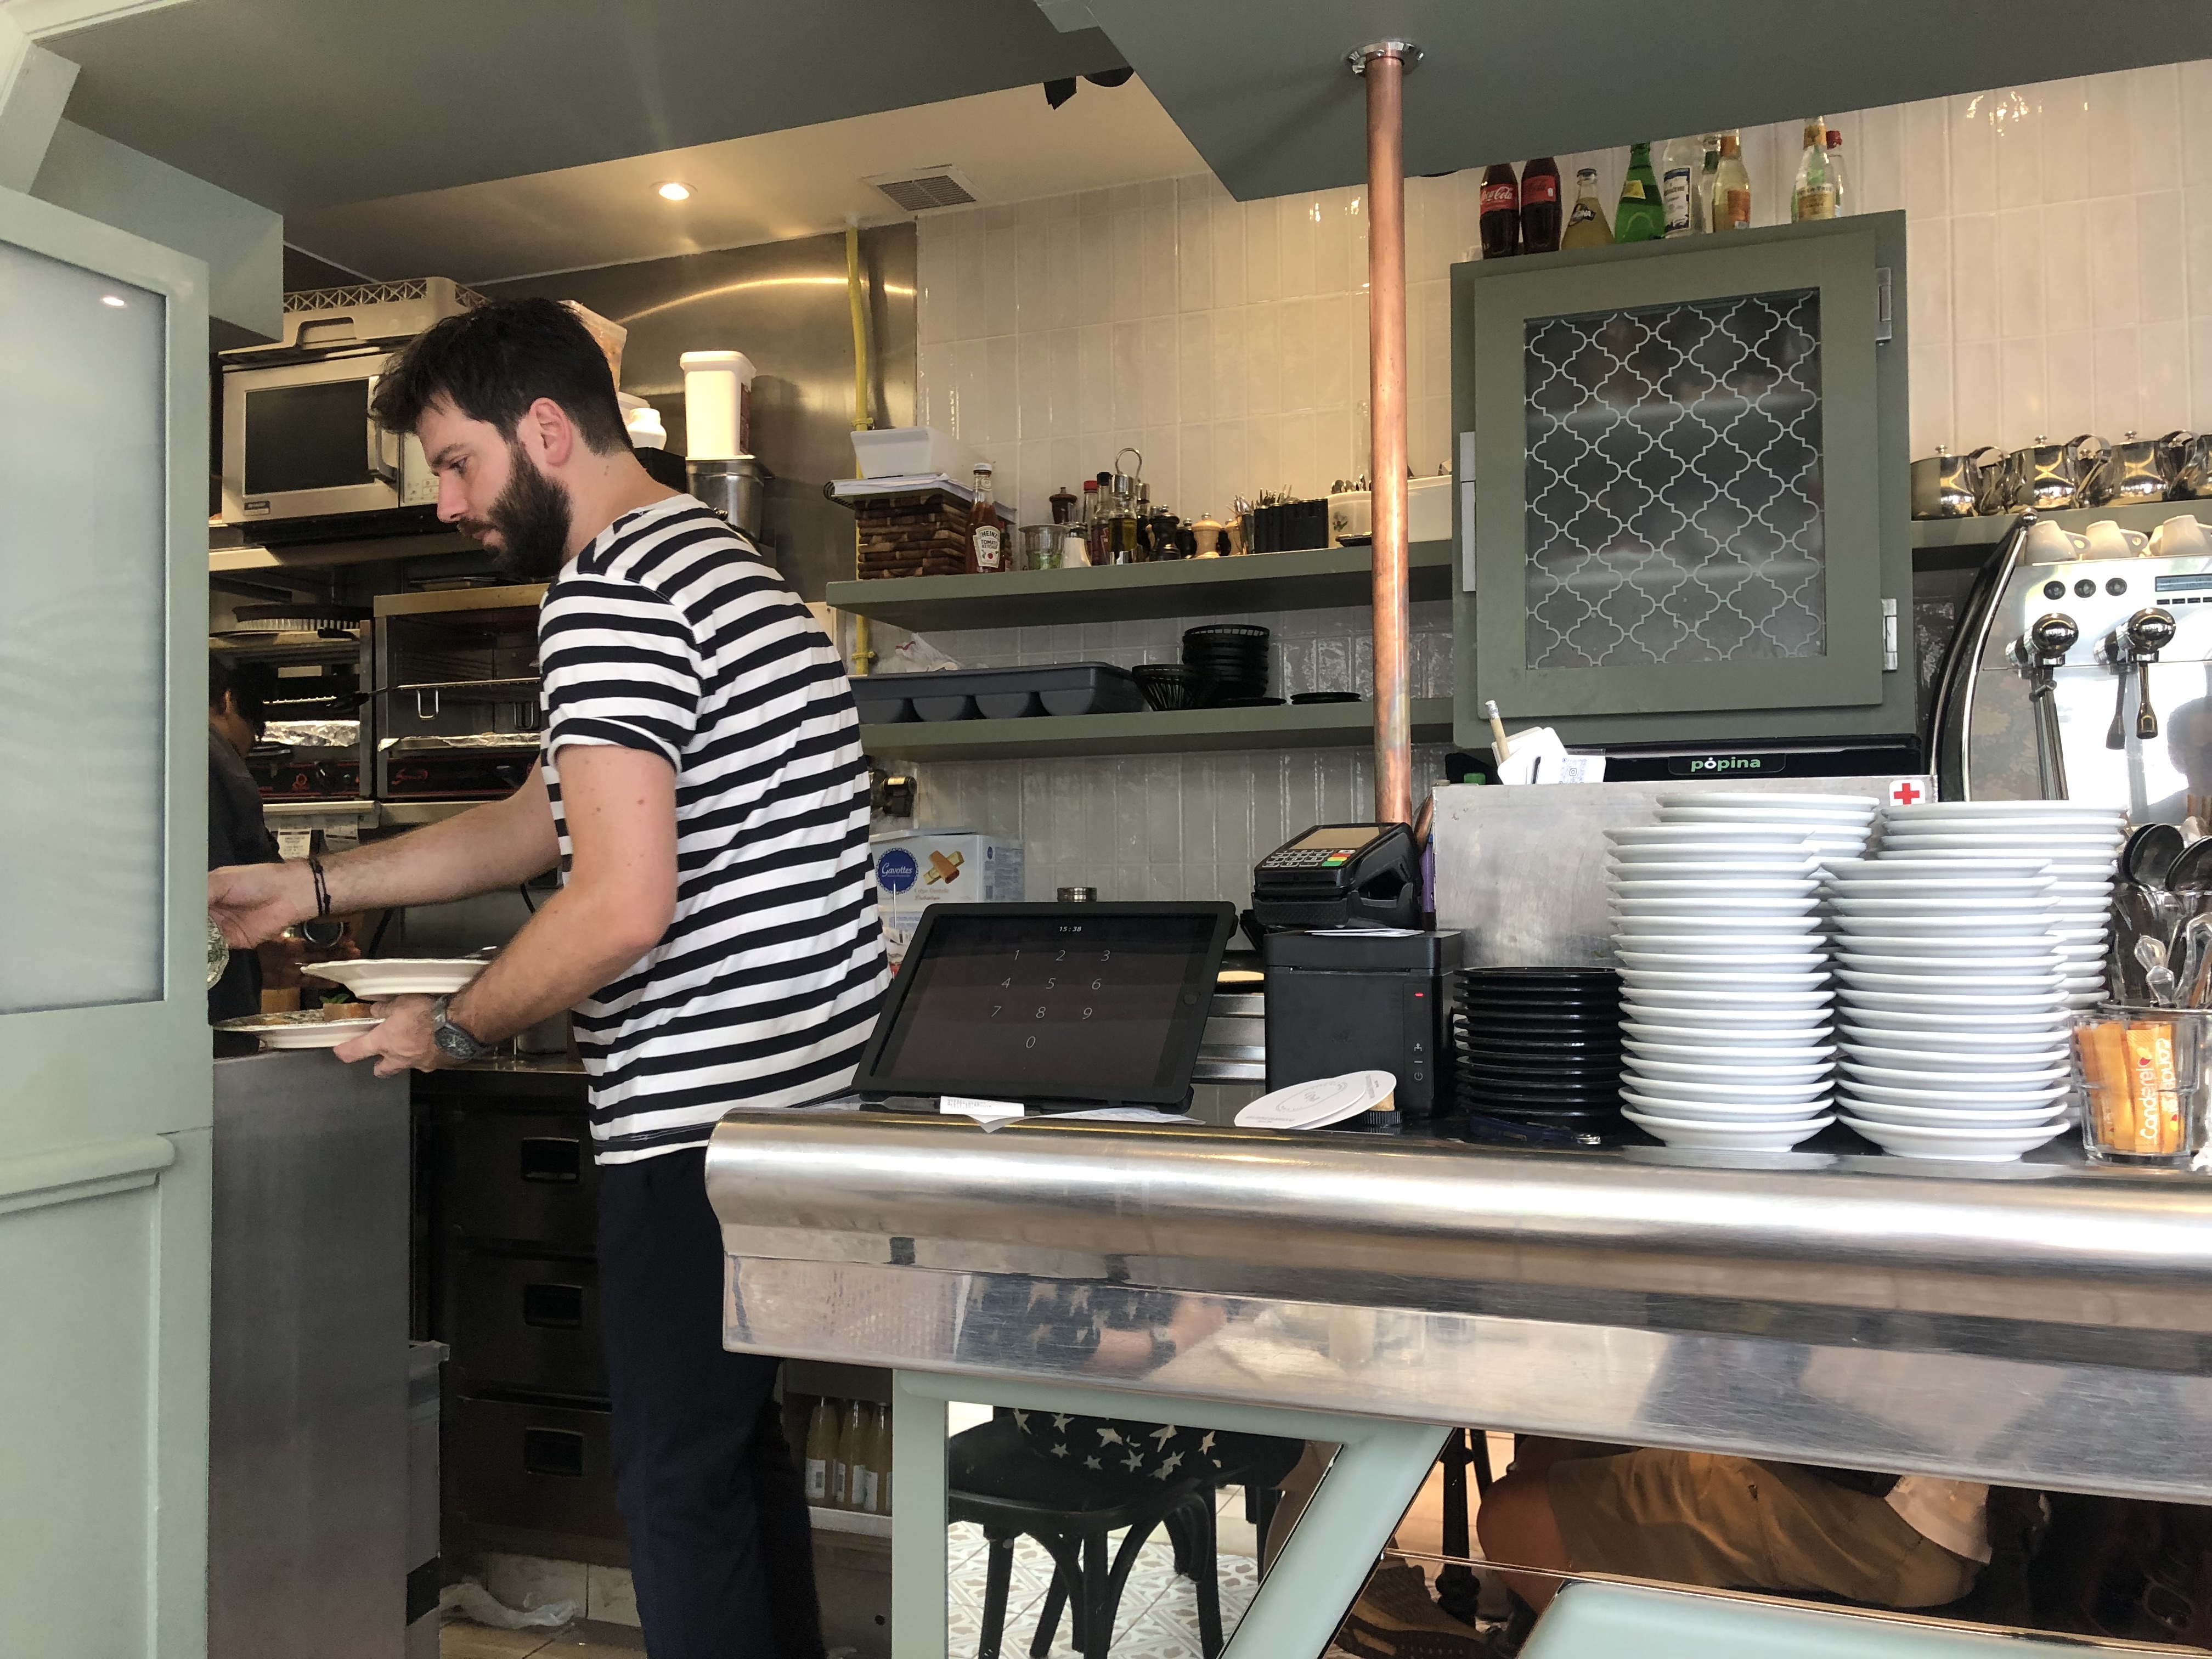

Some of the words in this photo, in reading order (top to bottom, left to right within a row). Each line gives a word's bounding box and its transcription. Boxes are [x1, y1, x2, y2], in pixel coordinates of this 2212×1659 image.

[981, 530, 998, 538] HEINZ
[882, 862, 913, 877] Gavottes
[1015, 950, 1020, 961] 1
[1056, 950, 1066, 961] 2
[1101, 950, 1110, 962] 3
[1001, 977, 1011, 988] 4
[1046, 978, 1057, 989] 5
[1091, 978, 1102, 990] 6
[991, 1006, 1002, 1017] 7
[1036, 1006, 1046, 1018] 8
[1082, 1007, 1093, 1020] 9
[1025, 1036, 1036, 1048] 0
[2136, 1068, 2158, 1139] Canderel
